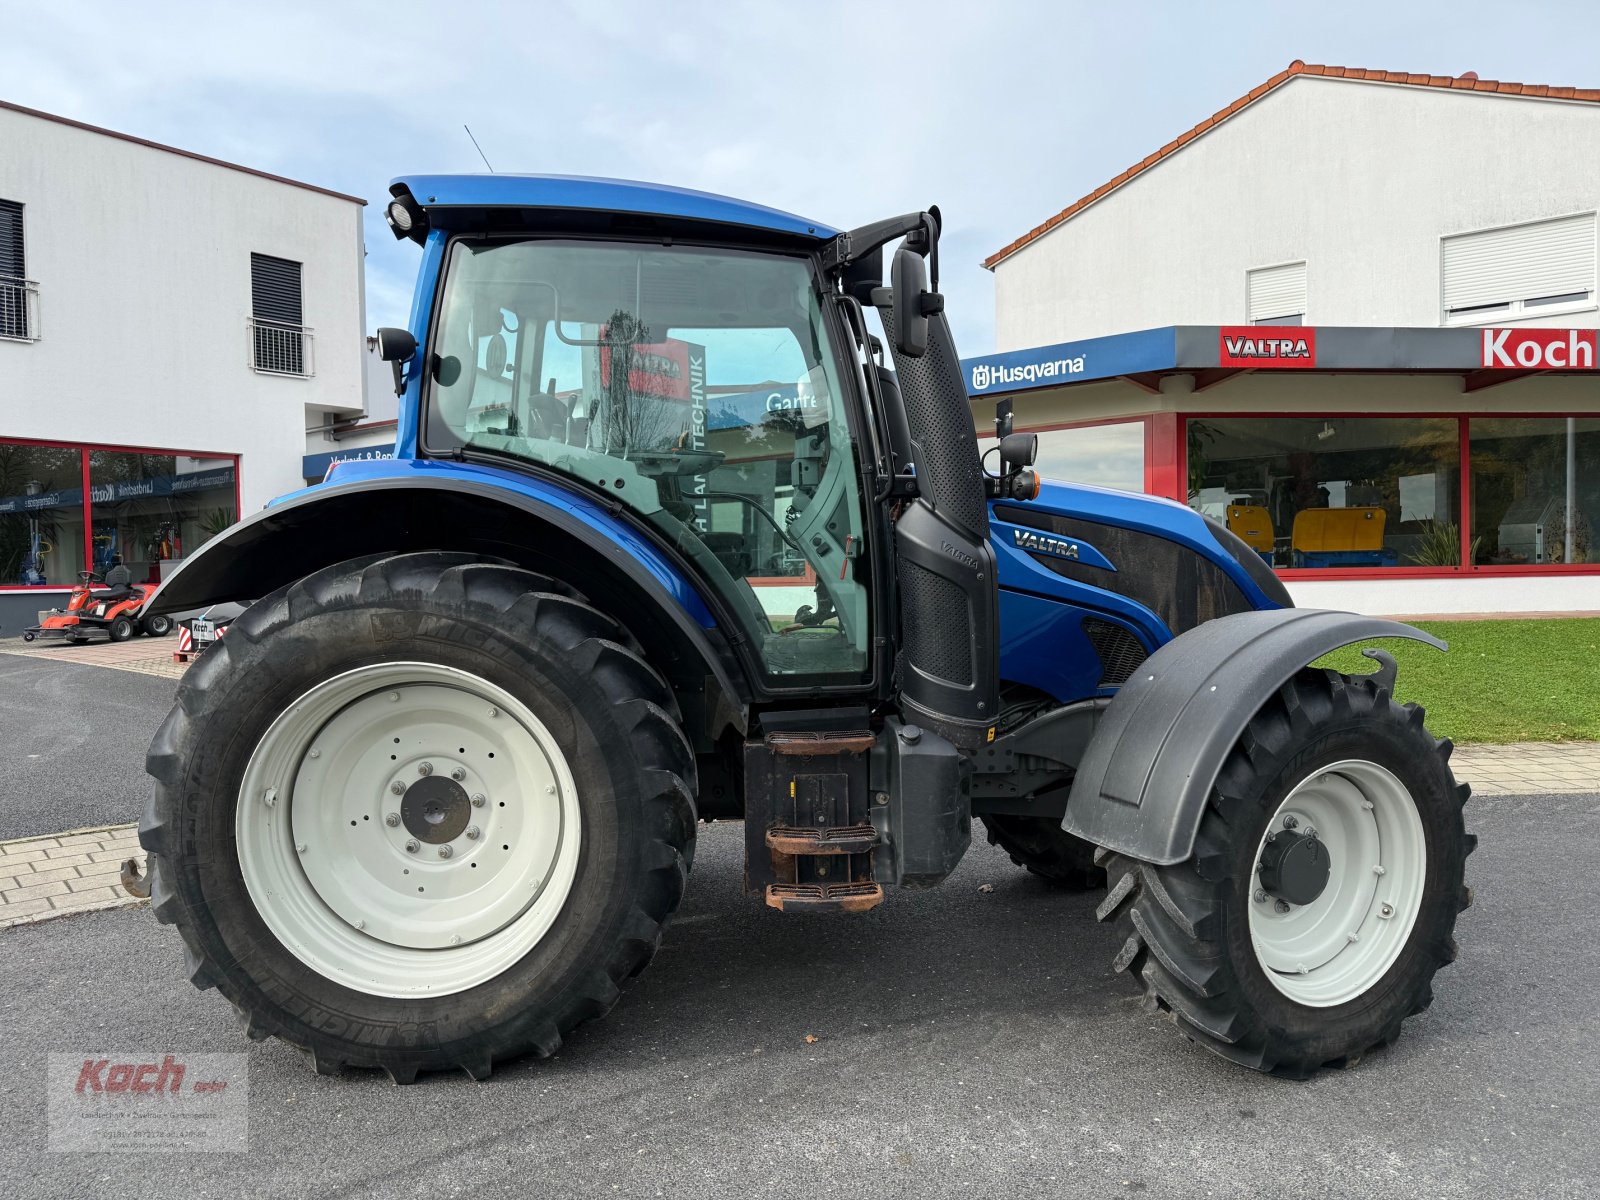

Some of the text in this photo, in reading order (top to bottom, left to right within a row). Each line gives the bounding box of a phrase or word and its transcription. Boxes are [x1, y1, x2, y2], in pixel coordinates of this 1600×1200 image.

[1223, 335, 1311, 360] VALTRA
[1484, 329, 1593, 368] Koch
[991, 356, 1084, 385] Husqvarna
[940, 540, 978, 570] VALTRA
[1014, 530, 1079, 559] VALTRA
